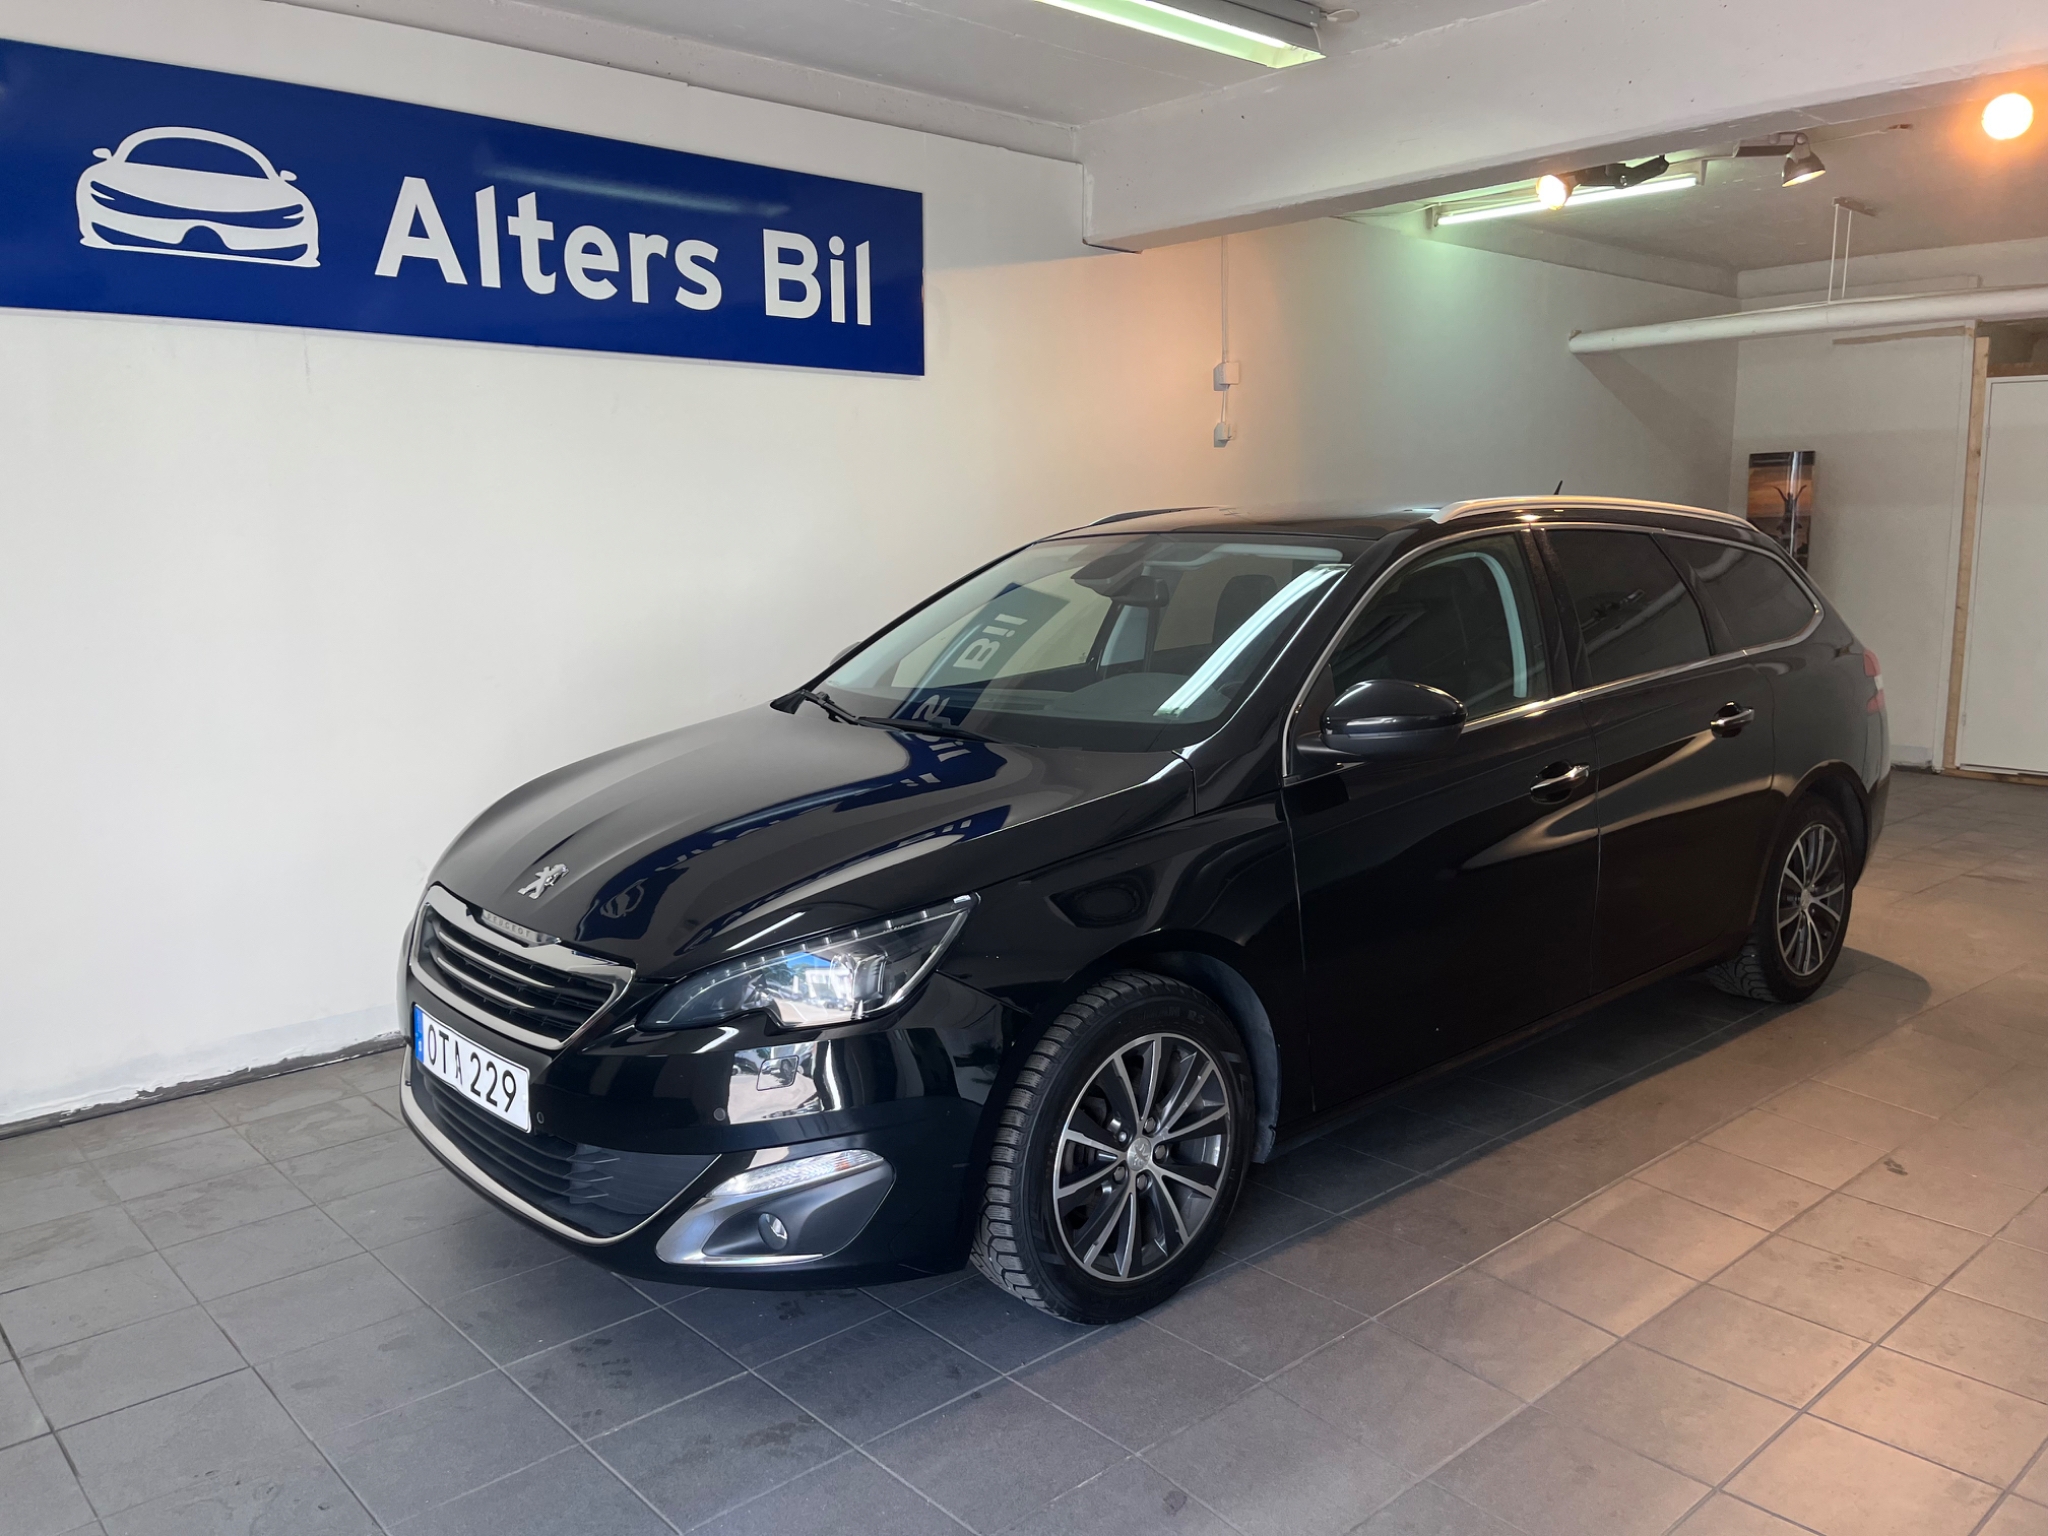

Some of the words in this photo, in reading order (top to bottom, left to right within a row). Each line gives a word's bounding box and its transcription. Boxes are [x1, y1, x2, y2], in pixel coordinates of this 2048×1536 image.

[375, 176, 722, 311] Alters
[763, 228, 872, 326] Bil
[486, 913, 531, 938] PEUGEOT
[428, 1024, 463, 1086] OTA
[470, 1051, 517, 1113] 229
